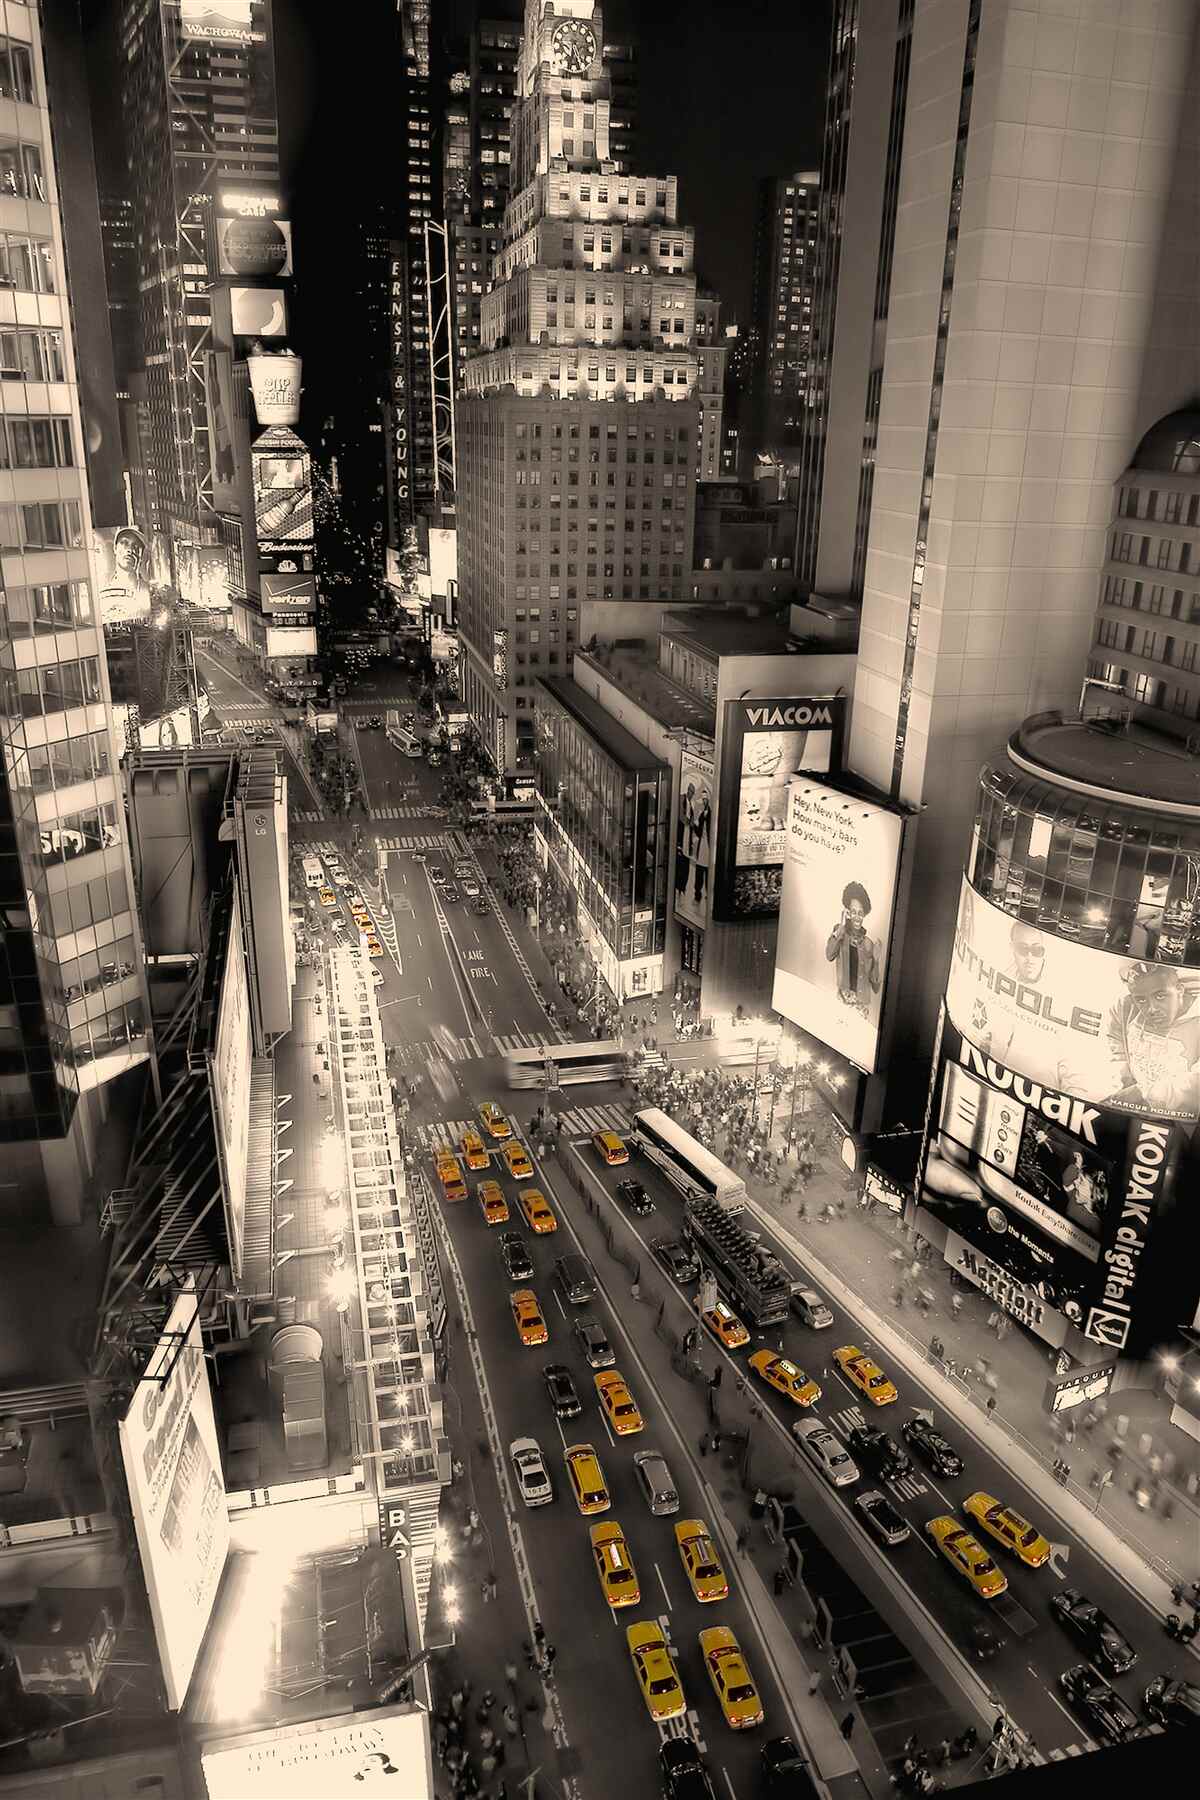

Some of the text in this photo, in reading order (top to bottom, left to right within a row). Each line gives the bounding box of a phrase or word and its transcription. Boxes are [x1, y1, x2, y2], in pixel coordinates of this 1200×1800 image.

[391, 261, 403, 355] ERNST
[395, 407, 409, 499] YOUNG
[256, 541, 314, 552] Budweiser
[745, 706, 833, 726] VIACOM
[793, 795, 813, 812] Hey,
[813, 802, 833, 819] New
[791, 824, 803, 836] do
[803, 831, 819, 844] you
[792, 809, 858, 846] How many bars
[955, 940, 1102, 1037] UTHPOLE
[1110, 1098, 1195, 1119] MARCUS HOUSTON
[1015, 1189, 1041, 1214] Kodak
[1103, 1122, 1170, 1312] KODAK digital
[1007, 1224, 1055, 1264] the Moments
[957, 1248, 1044, 1324] Marriott
